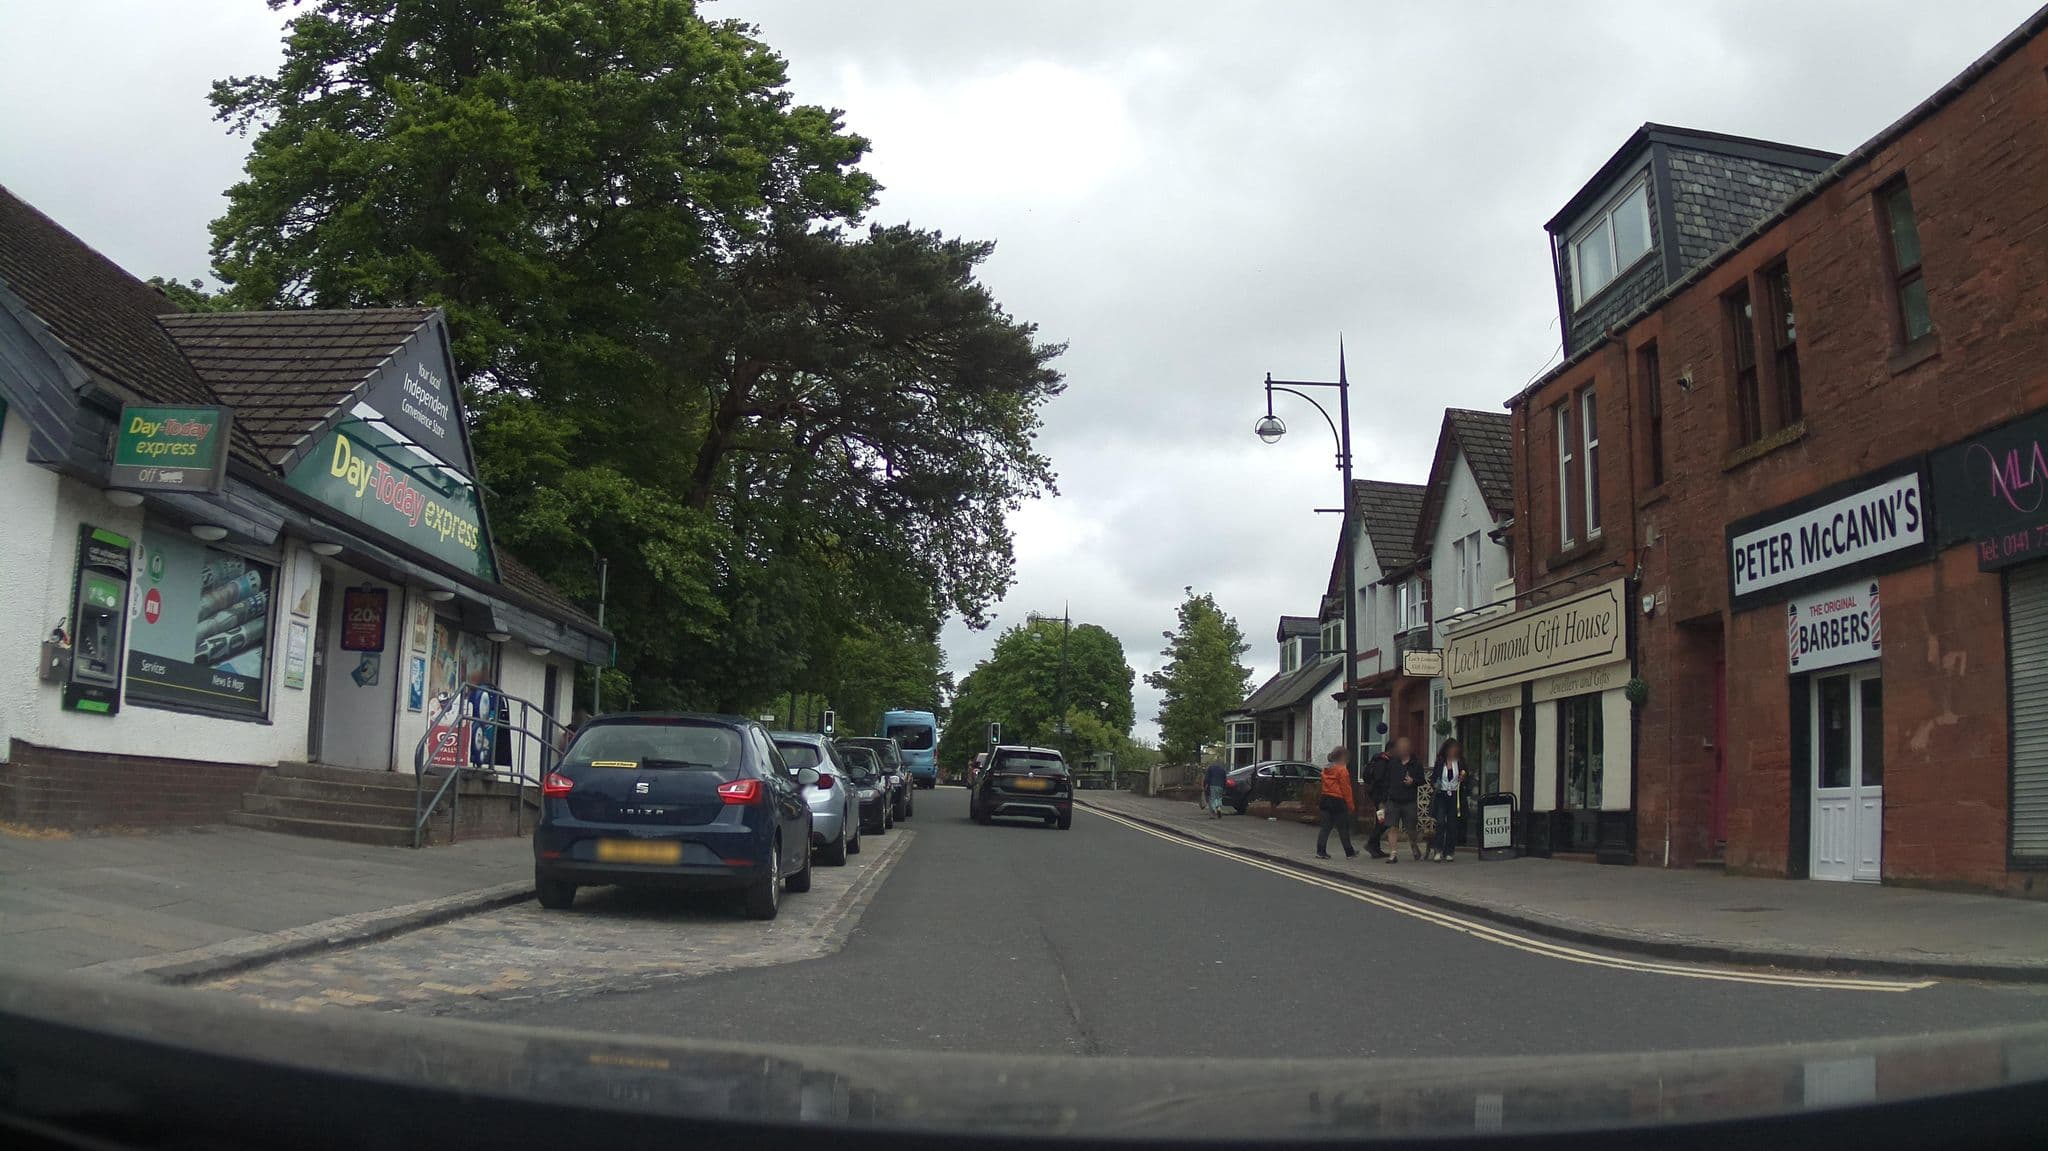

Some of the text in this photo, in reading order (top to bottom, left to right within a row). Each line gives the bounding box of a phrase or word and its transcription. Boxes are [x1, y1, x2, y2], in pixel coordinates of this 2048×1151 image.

[418, 361, 441, 390] Your local
[403, 372, 448, 420] Independent
[129, 416, 213, 440] Day-Today
[402, 398, 445, 438] Convenience Store
[136, 441, 197, 457] express
[330, 434, 479, 550] Day-Today express
[1735, 487, 1920, 585] PETER McCANN'S
[1809, 596, 1857, 617] THE ORIGINAL
[1454, 610, 1610, 674] Loch Lomond Gift House
[1800, 611, 1870, 654] BARBERS
[141, 659, 167, 675] Services
[1551, 670, 1610, 695] Jewellery and Gifts
[1485, 817, 1508, 826] GIFT
[1485, 826, 1510, 835] SHOP
